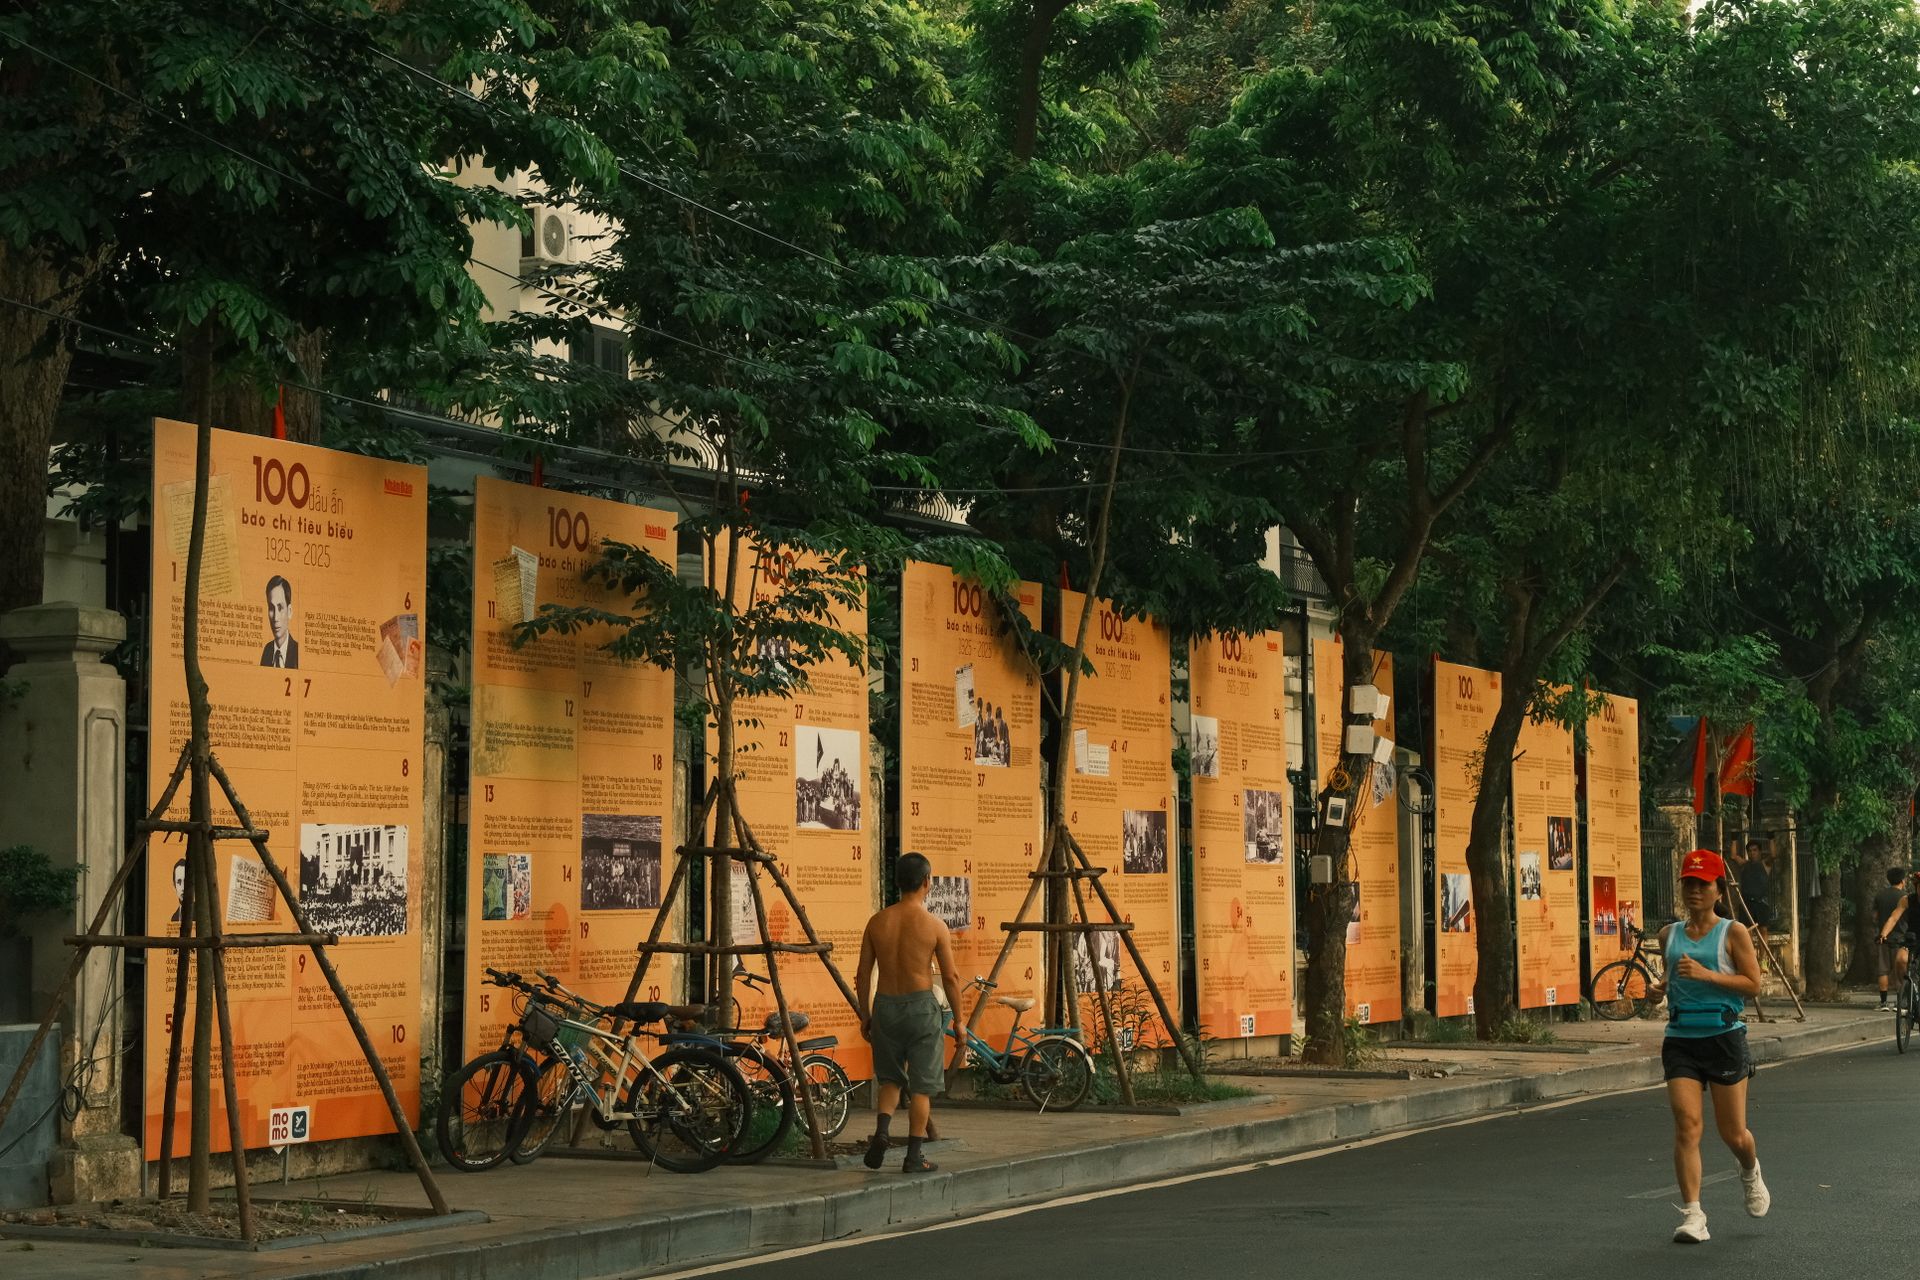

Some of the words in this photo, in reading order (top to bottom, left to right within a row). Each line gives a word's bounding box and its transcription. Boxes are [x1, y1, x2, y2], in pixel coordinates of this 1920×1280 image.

[253, 455, 310, 509] 100
[308, 486, 328, 513] dấu
[330, 488, 344, 516] ấn
[272, 514, 291, 532] chí
[298, 515, 322, 537] tiêu
[547, 506, 590, 552] 100
[265, 536, 291, 563] 1925
[303, 542, 331, 568] 2025
[171, 562, 177, 582] 1
[404, 592, 411, 610] 6
[952, 580, 982, 618] 100
[487, 600, 496, 619] 11
[1100, 609, 1123, 643] 100
[1222, 632, 1242, 662] 100
[911, 657, 919, 673] 31
[284, 678, 291, 697] 2
[304, 679, 312, 698] 7
[583, 681, 592, 698] 17
[1458, 675, 1473, 700] 100
[564, 700, 574, 717] 12
[794, 703, 804, 720] 27
[778, 731, 789, 747] 22
[652, 754, 663, 771] 18
[963, 746, 972, 761] 32
[402, 758, 409, 777] 8
[977, 773, 986, 787] 37
[484, 784, 494, 803] 13
[911, 801, 920, 816] 33
[851, 845, 862, 861] 28
[1023, 842, 1033, 856] 38
[562, 864, 572, 882] 14
[780, 862, 790, 878] 24
[963, 859, 972, 874] 34
[579, 921, 589, 939] 19
[977, 916, 986, 930] 39
[299, 954, 306, 973] 9
[1024, 966, 1033, 981] 40
[479, 994, 490, 1013] 15
[391, 1024, 406, 1043] 10
